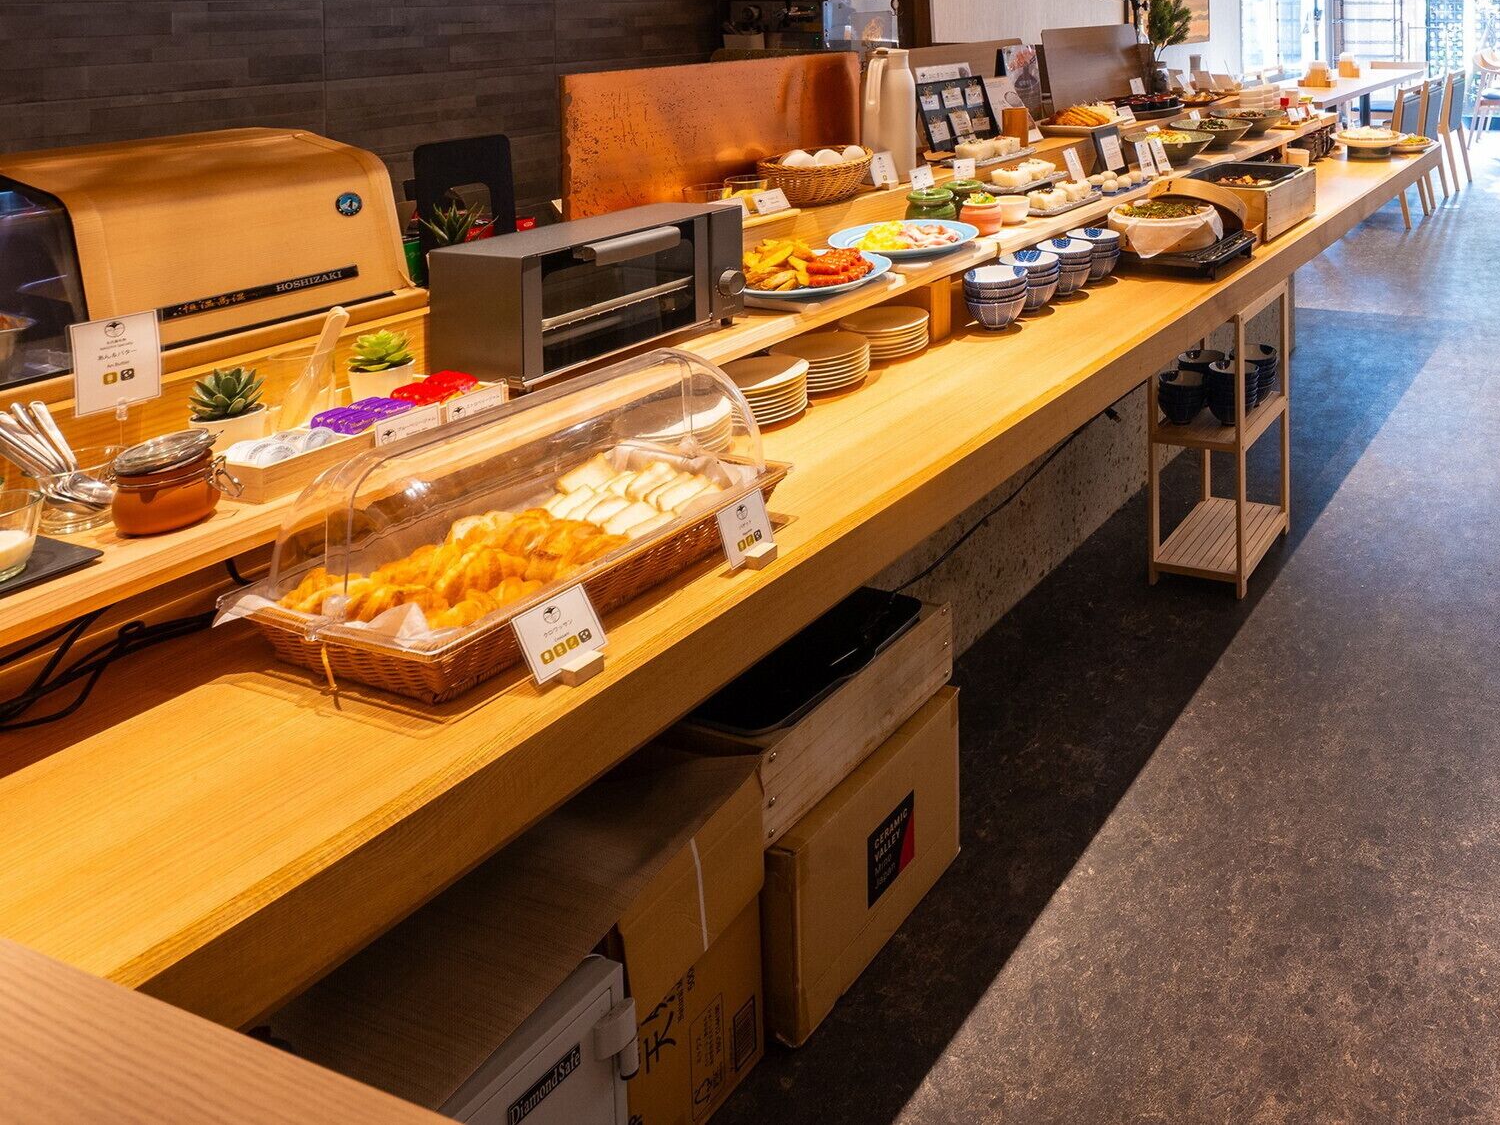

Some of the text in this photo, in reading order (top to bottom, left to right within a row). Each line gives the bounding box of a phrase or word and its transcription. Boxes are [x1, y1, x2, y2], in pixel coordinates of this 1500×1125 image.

[275, 270, 343, 292] HOSHIZAKI
[874, 808, 908, 849] CERAMIC
[874, 828, 901, 863] VALLEY
